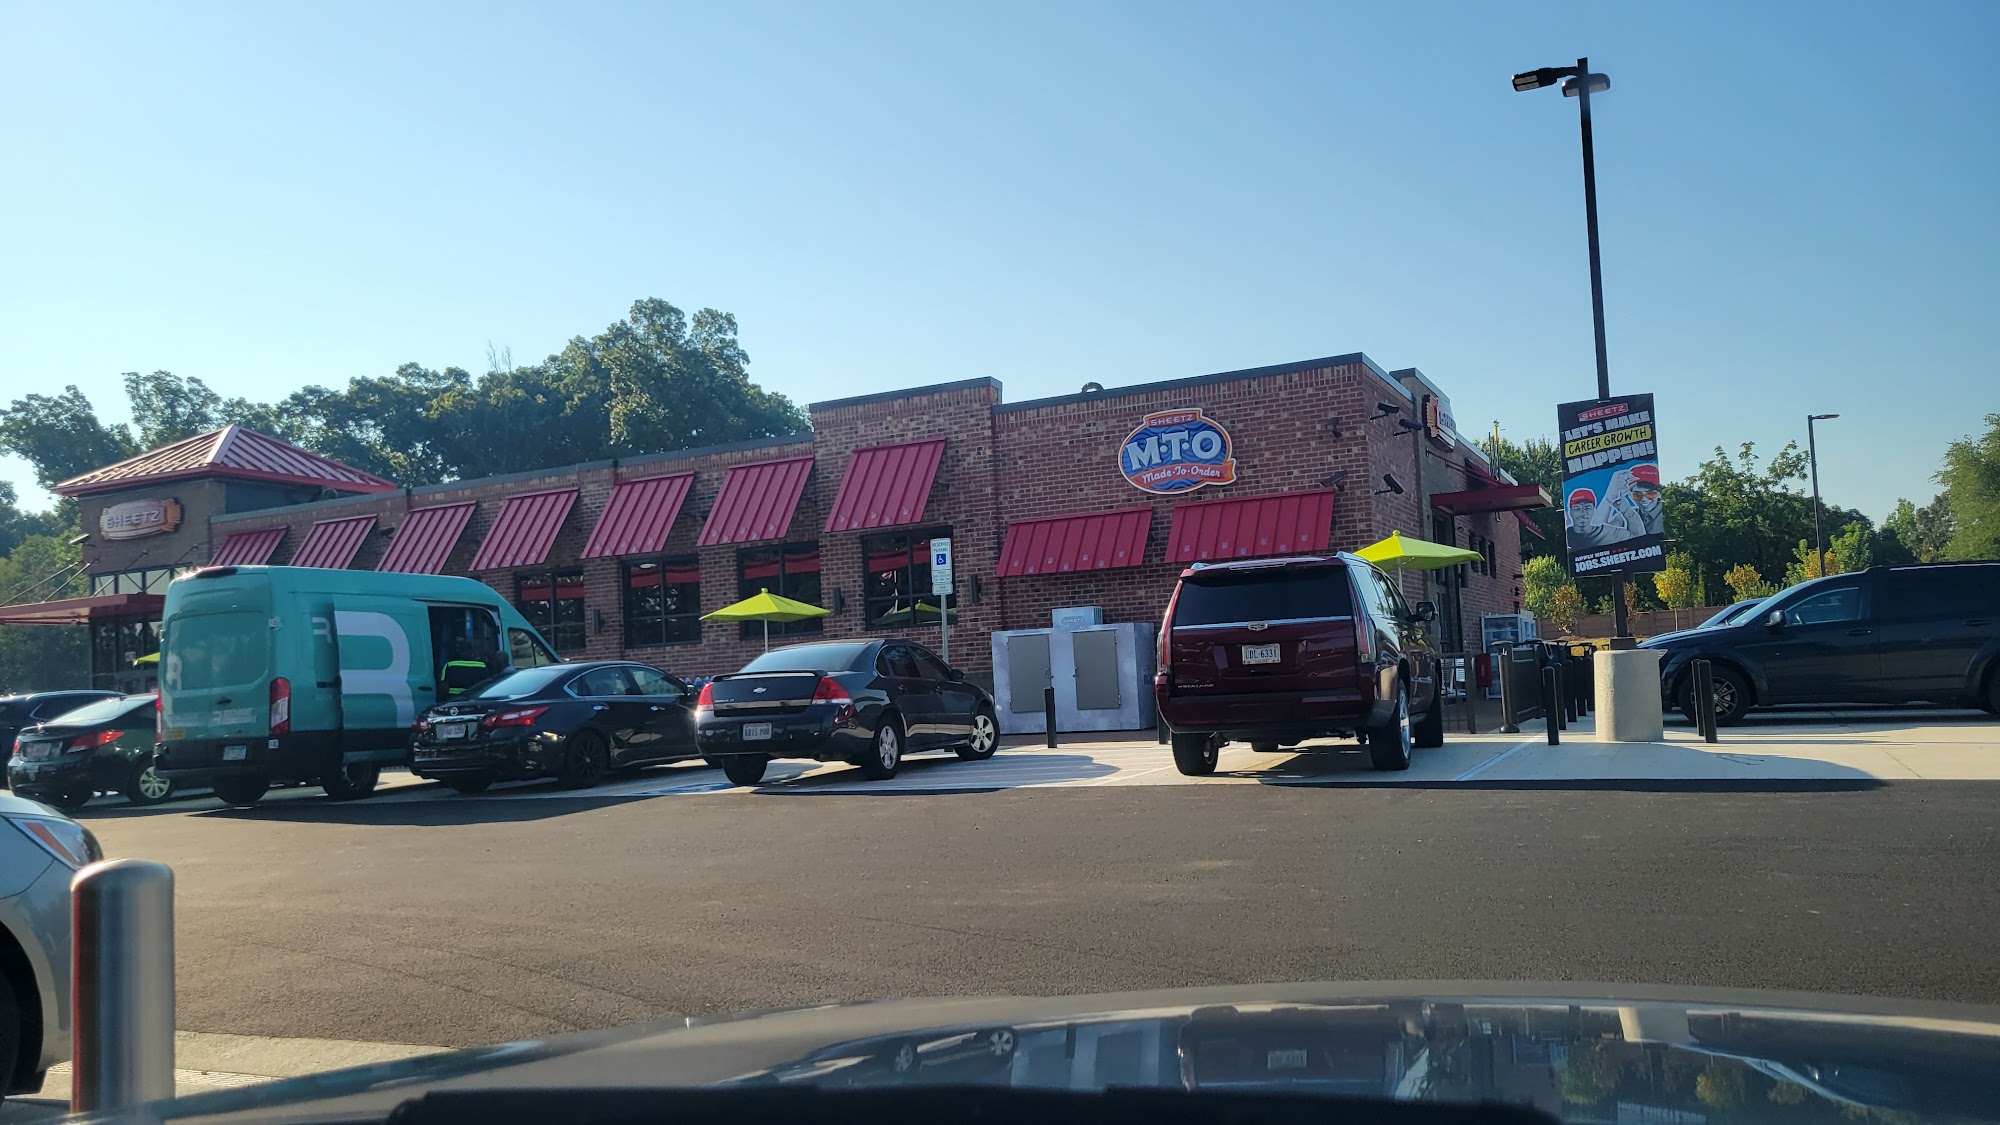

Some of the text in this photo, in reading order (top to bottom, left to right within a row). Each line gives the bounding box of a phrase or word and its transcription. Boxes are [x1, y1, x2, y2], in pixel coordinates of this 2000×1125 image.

[1151, 414, 1194, 426] SHEETZ
[1580, 404, 1626, 420] SHEETZ
[1564, 410, 1650, 441] LET'S MAKE
[1568, 427, 1647, 455] CAREER GROWTH
[1567, 441, 1655, 474] HAPPEN!
[106, 510, 160, 529] SHEETZ
[1575, 549, 1610, 563] APPLY NOW
[1575, 545, 1662, 573] JOBS.SHEETZ.COM
